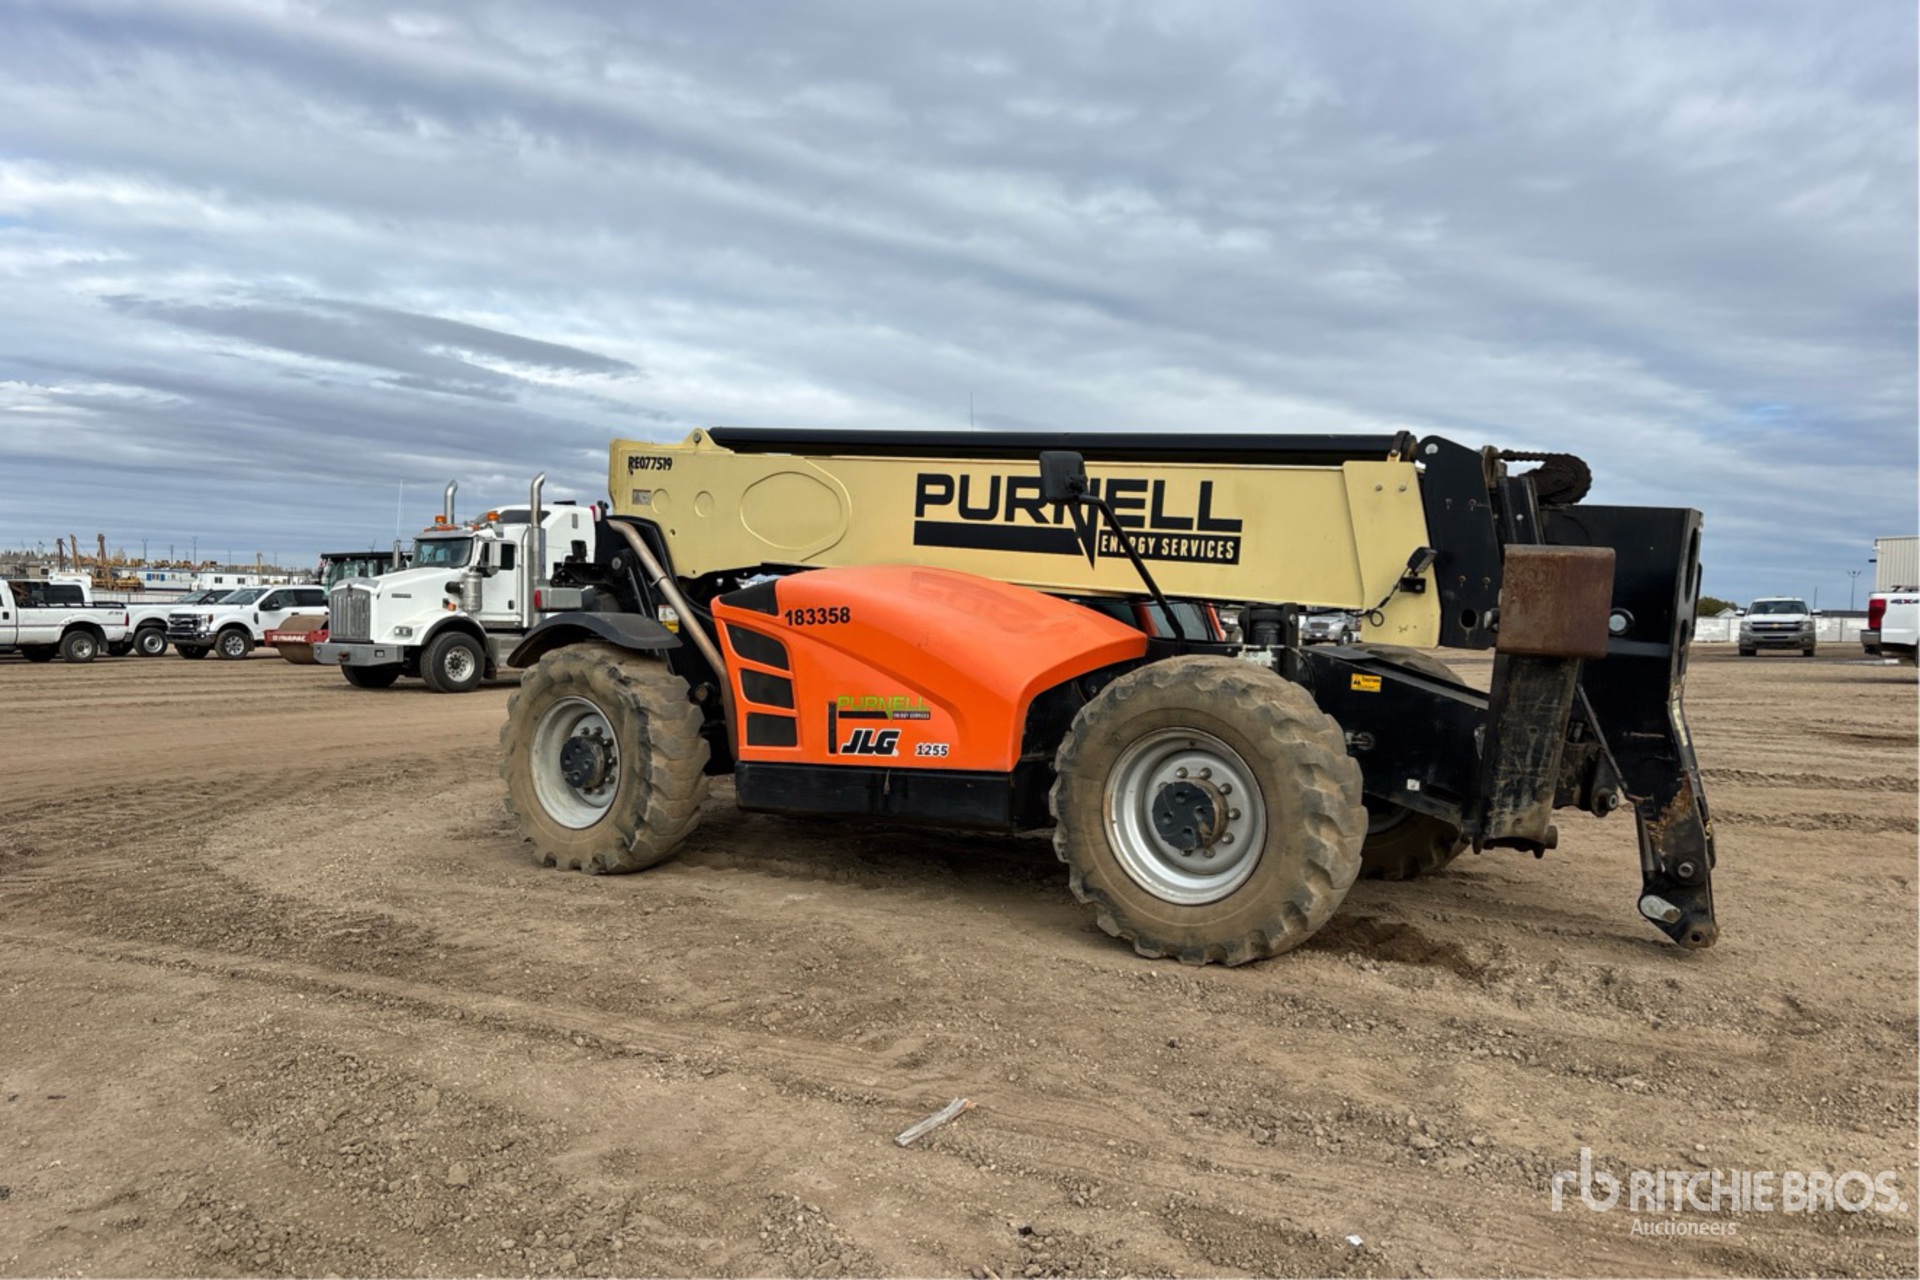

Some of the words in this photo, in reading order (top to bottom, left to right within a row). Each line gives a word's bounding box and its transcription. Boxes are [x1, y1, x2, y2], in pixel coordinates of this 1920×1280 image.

[628, 456, 673, 471] RE077519
[914, 473, 1243, 570] PURNELL
[1161, 538, 1235, 559] SERVICES
[785, 606, 851, 626] 183358
[837, 696, 930, 720] PURNELL
[840, 728, 901, 756] JLG
[915, 743, 950, 757] 1255
